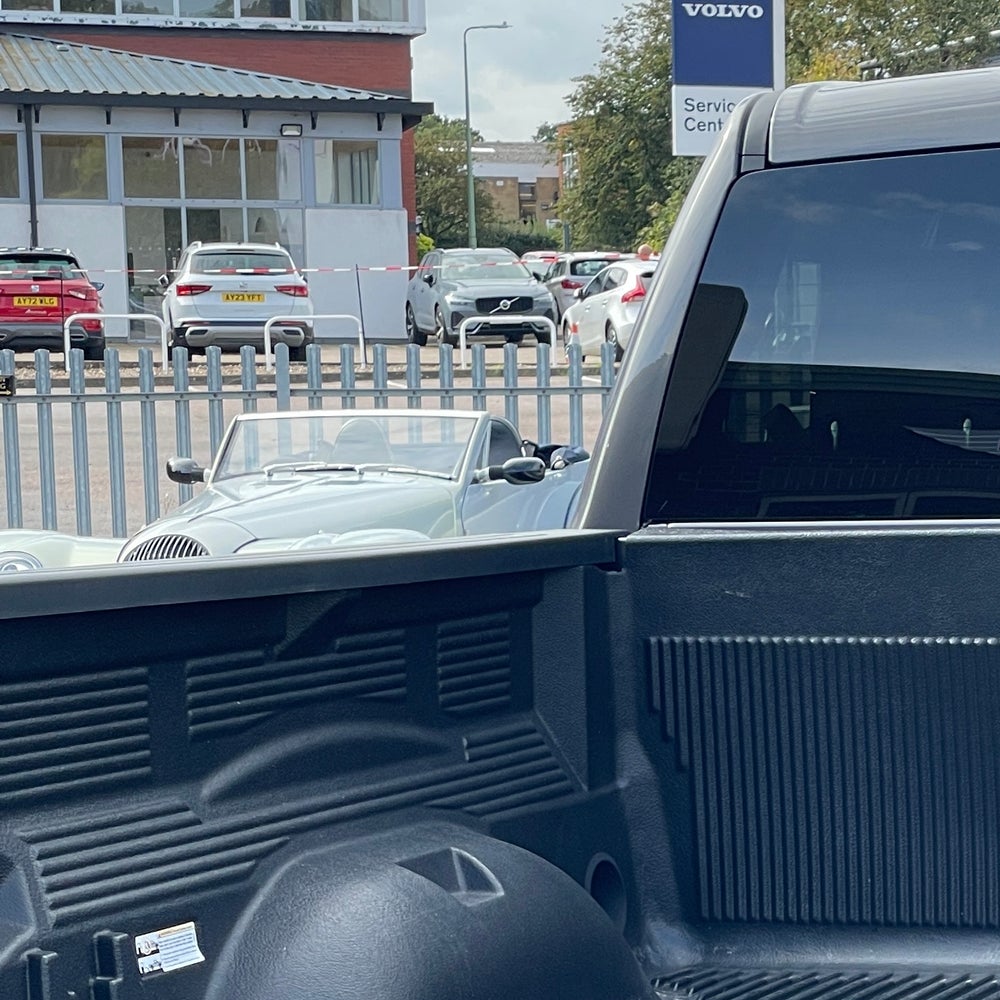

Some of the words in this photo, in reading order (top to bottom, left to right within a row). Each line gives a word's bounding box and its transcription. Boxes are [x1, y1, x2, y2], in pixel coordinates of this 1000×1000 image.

[682, 3, 764, 18] VOLVO
[684, 98, 735, 112] Servic
[684, 117, 724, 132] Cent
